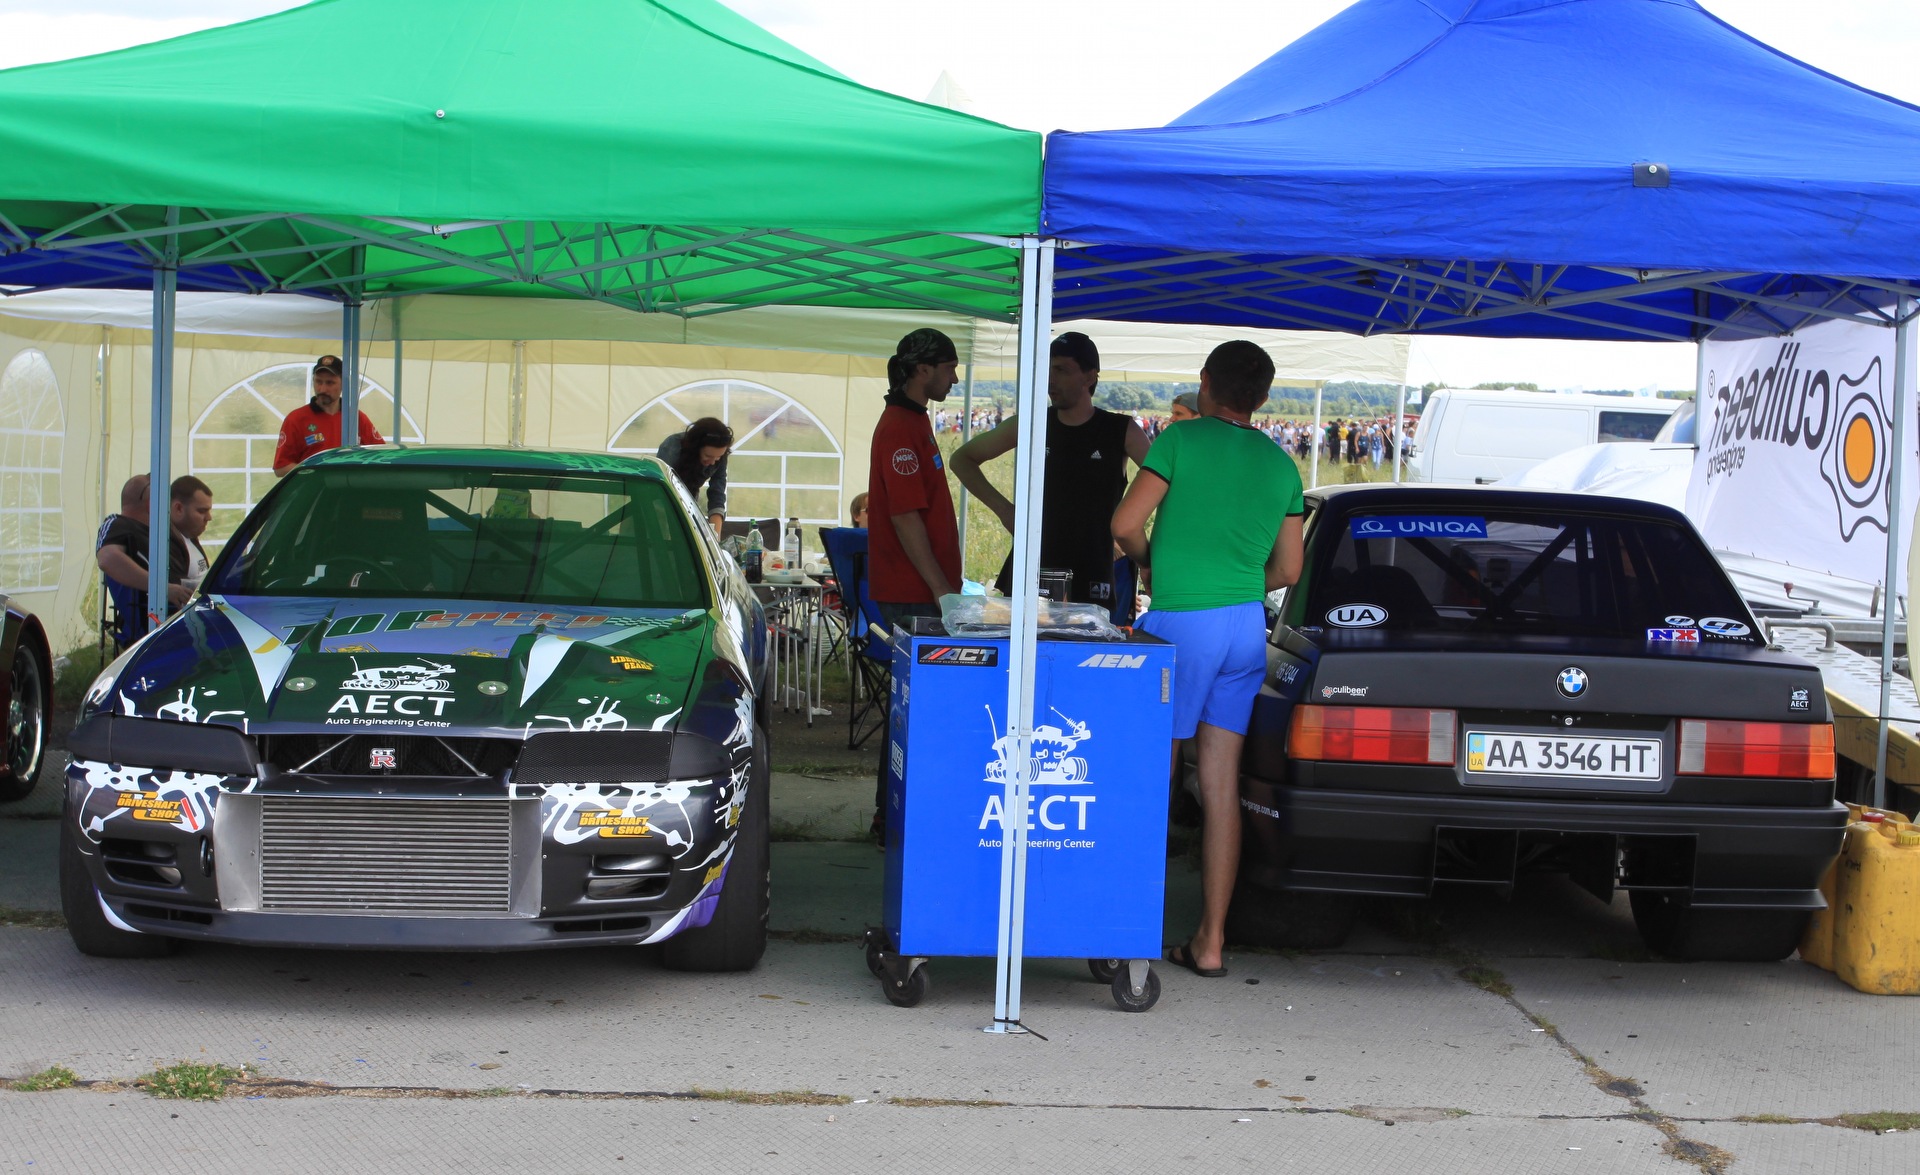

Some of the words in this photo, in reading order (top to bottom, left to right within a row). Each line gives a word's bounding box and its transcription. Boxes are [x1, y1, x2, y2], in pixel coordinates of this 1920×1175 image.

[895, 454, 913, 463] NGK
[1398, 521, 1482, 533] UNIQA
[1337, 609, 1377, 622] UA
[1650, 629, 1697, 640] NX
[1705, 634, 1754, 642] PISTONS
[1077, 653, 1148, 668] AEM
[1332, 686, 1367, 694] culibeen
[328, 695, 456, 716] AECT
[1790, 700, 1809, 708] AECT
[325, 717, 350, 725] Auto
[352, 717, 414, 728] Engineering
[416, 719, 451, 728] Center
[1487, 739, 1528, 768] AA
[1537, 741, 1603, 771] 3546
[1610, 744, 1652, 773] HT
[1470, 758, 1483, 766] UA
[117, 798, 181, 810] DRIVESHAFT
[150, 809, 181, 819] SHOP
[579, 817, 649, 826] DRIVESHAFT
[617, 825, 651, 834] SHOP
[978, 838, 1002, 848] Auto
[1063, 838, 1096, 848] Center
